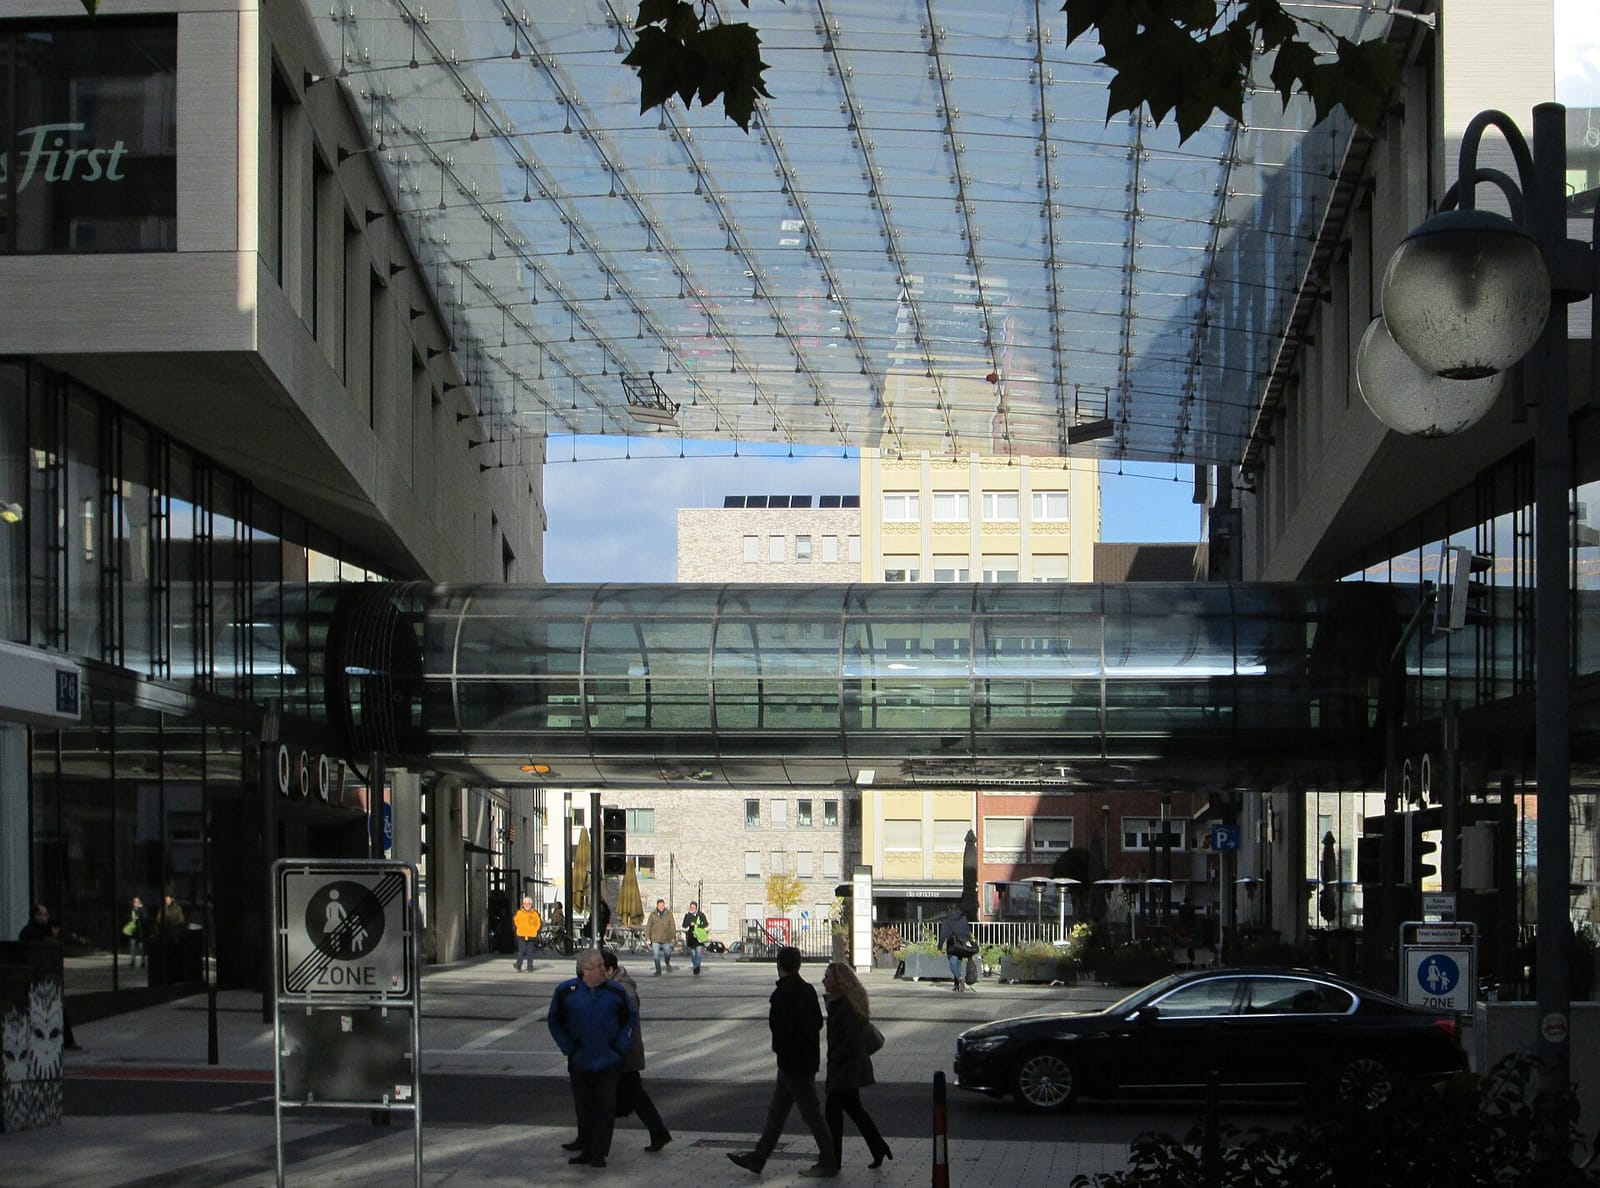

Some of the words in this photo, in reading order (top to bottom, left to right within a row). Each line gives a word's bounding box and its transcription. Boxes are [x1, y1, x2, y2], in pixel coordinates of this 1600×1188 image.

[15, 122, 129, 193] First
[59, 673, 75, 699] P6
[1216, 831, 1228, 849] P
[317, 966, 378, 986] ZONE
